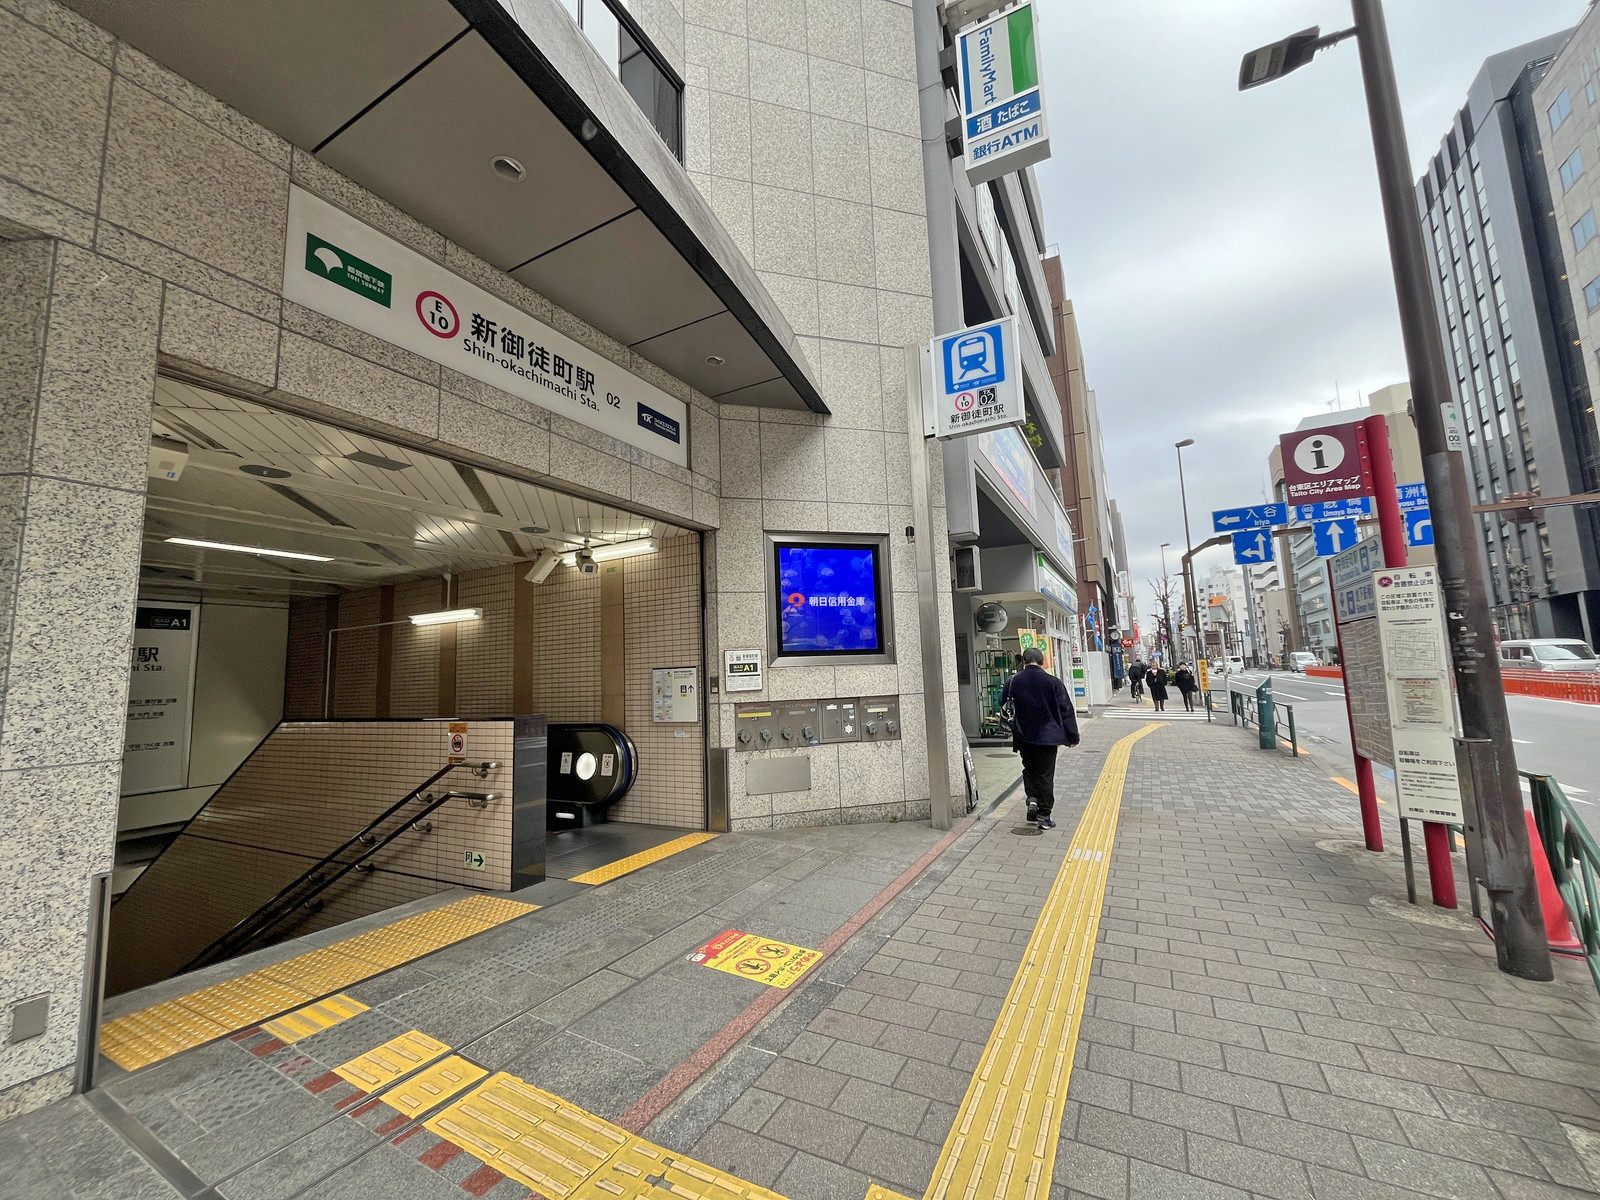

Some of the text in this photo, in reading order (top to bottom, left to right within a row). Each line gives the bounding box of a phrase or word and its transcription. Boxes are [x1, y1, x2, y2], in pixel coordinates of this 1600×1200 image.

[979, 26, 997, 106] FamilyMart
[977, 100, 1031, 134] 酒 たばこ
[972, 123, 1039, 160] 銀行ATM
[361, 279, 385, 295] SUBWAY
[435, 300, 443, 313] E
[430, 311, 449, 330] 10
[470, 312, 595, 396] 新御徒町駅
[463, 338, 600, 412] Shin-okachimachi Sta.
[606, 392, 621, 410] 02
[980, 393, 995, 405] 02
[950, 404, 1005, 424] 新御徒町駅
[1289, 475, 1361, 492] 台東区エリアマップ
[1290, 490, 1308, 498] Taito
[1309, 488, 1324, 496] City
[1344, 483, 1361, 491] Map
[1246, 505, 1277, 520] 入谷
[1346, 507, 1364, 515] Brdg.
[808, 596, 866, 607] 朝日信用金庫
[171, 618, 187, 627] A1
[744, 664, 754, 672] A1
